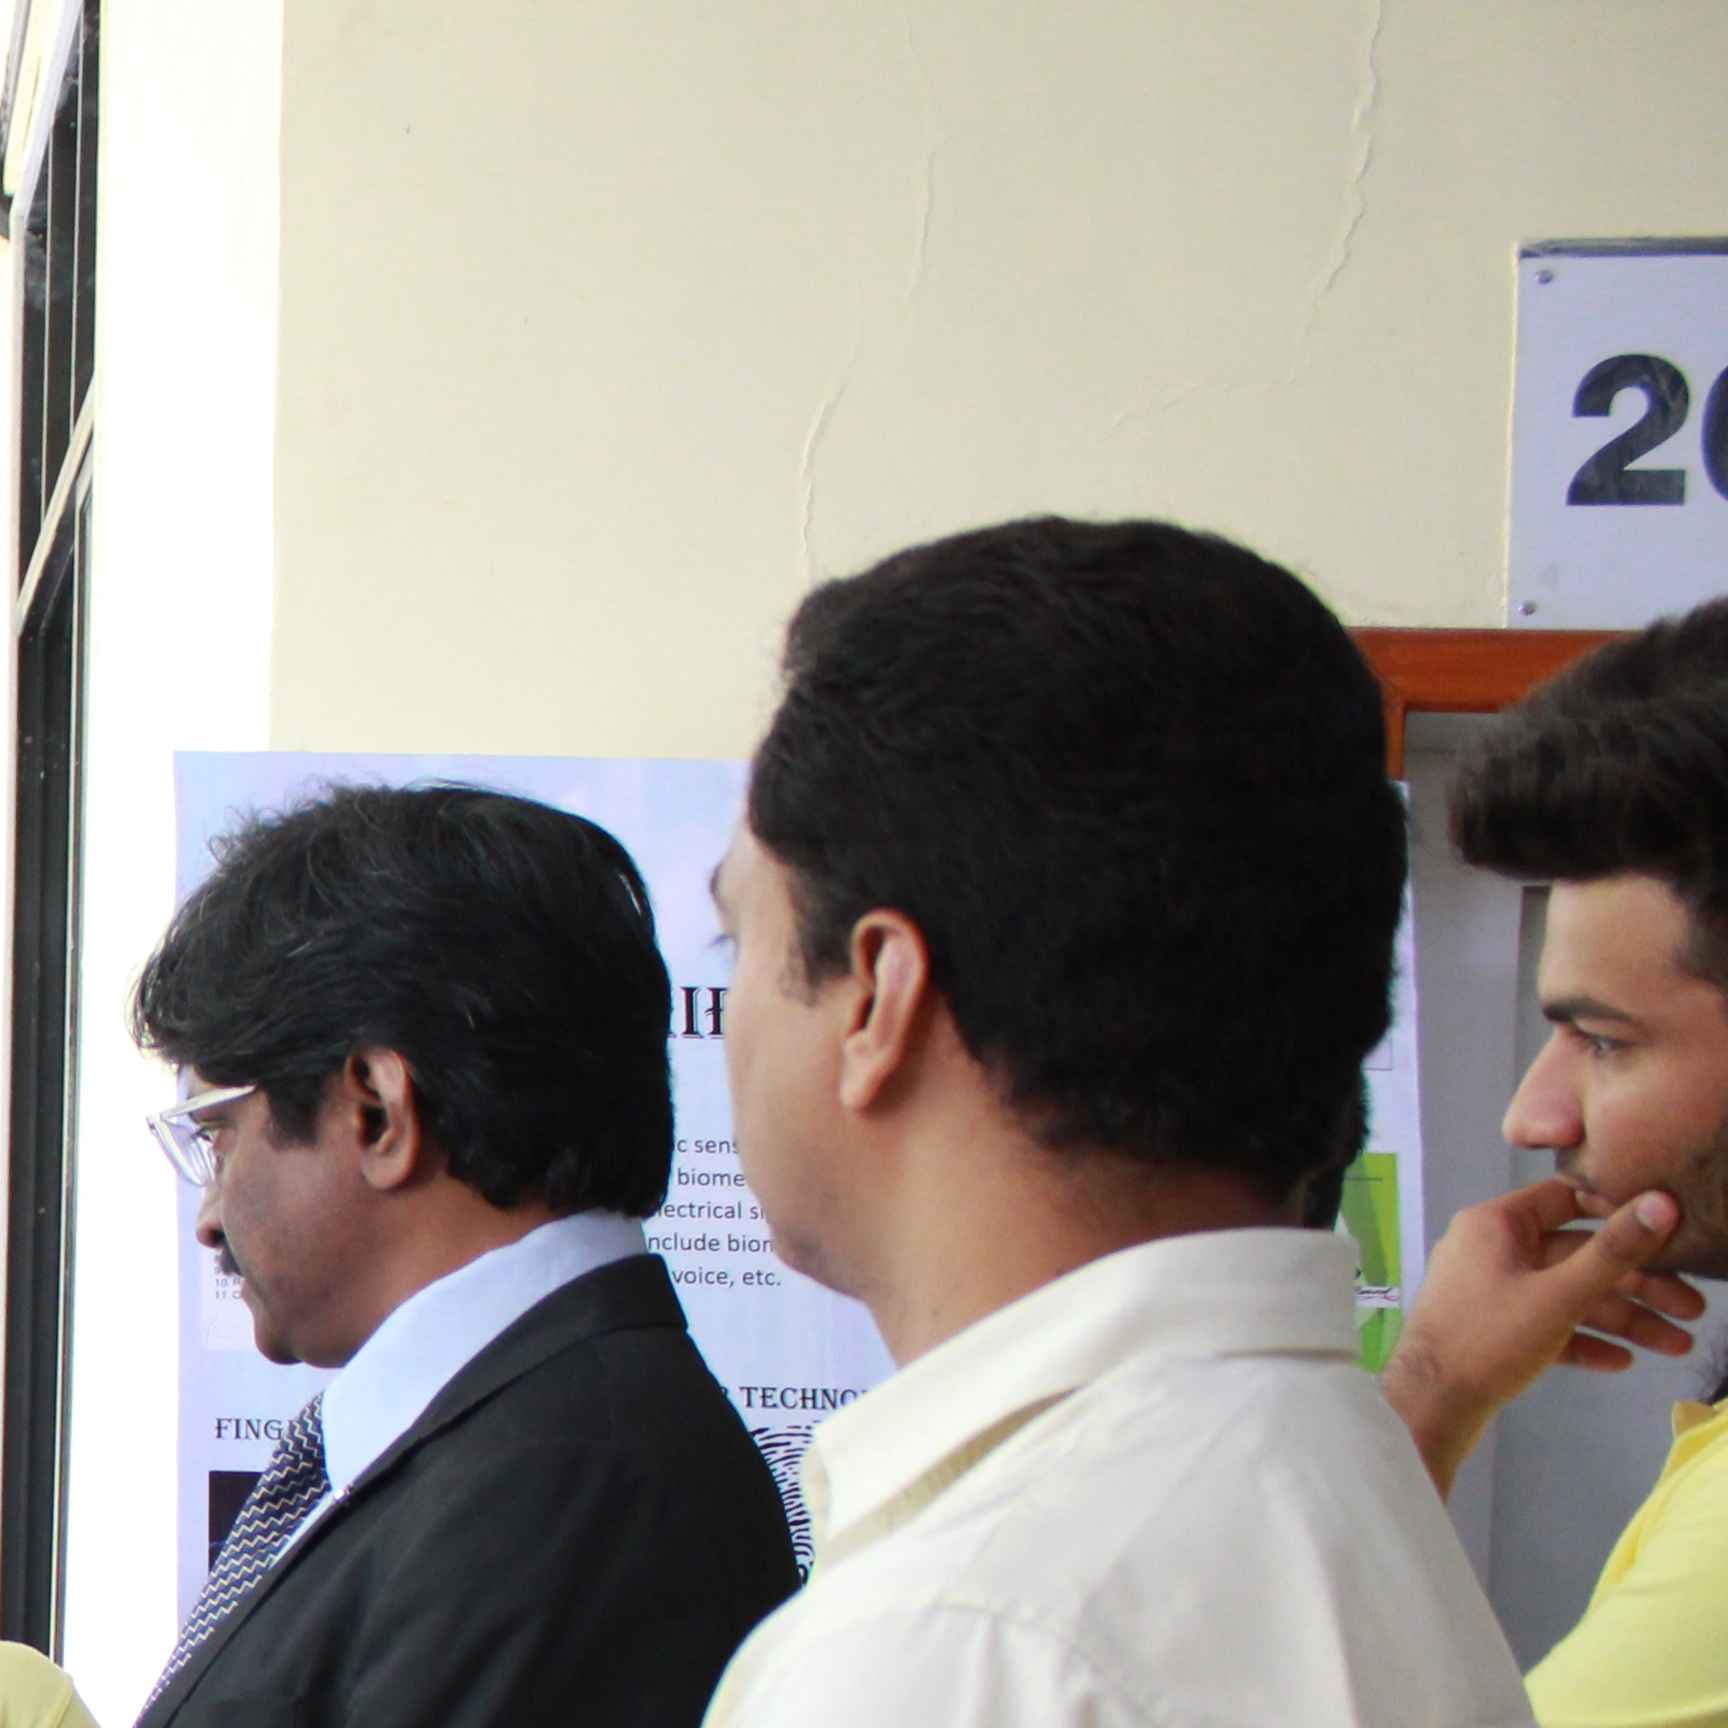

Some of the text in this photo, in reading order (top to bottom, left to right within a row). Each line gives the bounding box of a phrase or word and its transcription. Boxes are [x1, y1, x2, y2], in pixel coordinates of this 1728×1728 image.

[678, 1168, 745, 1187] biome
[658, 1202, 742, 1220] lectrical
[648, 1233, 720, 1252] nclude
[672, 1267, 781, 1287] voice, etc.
[739, 1387, 867, 1409] TECHNO
[216, 1418, 284, 1440] FING
